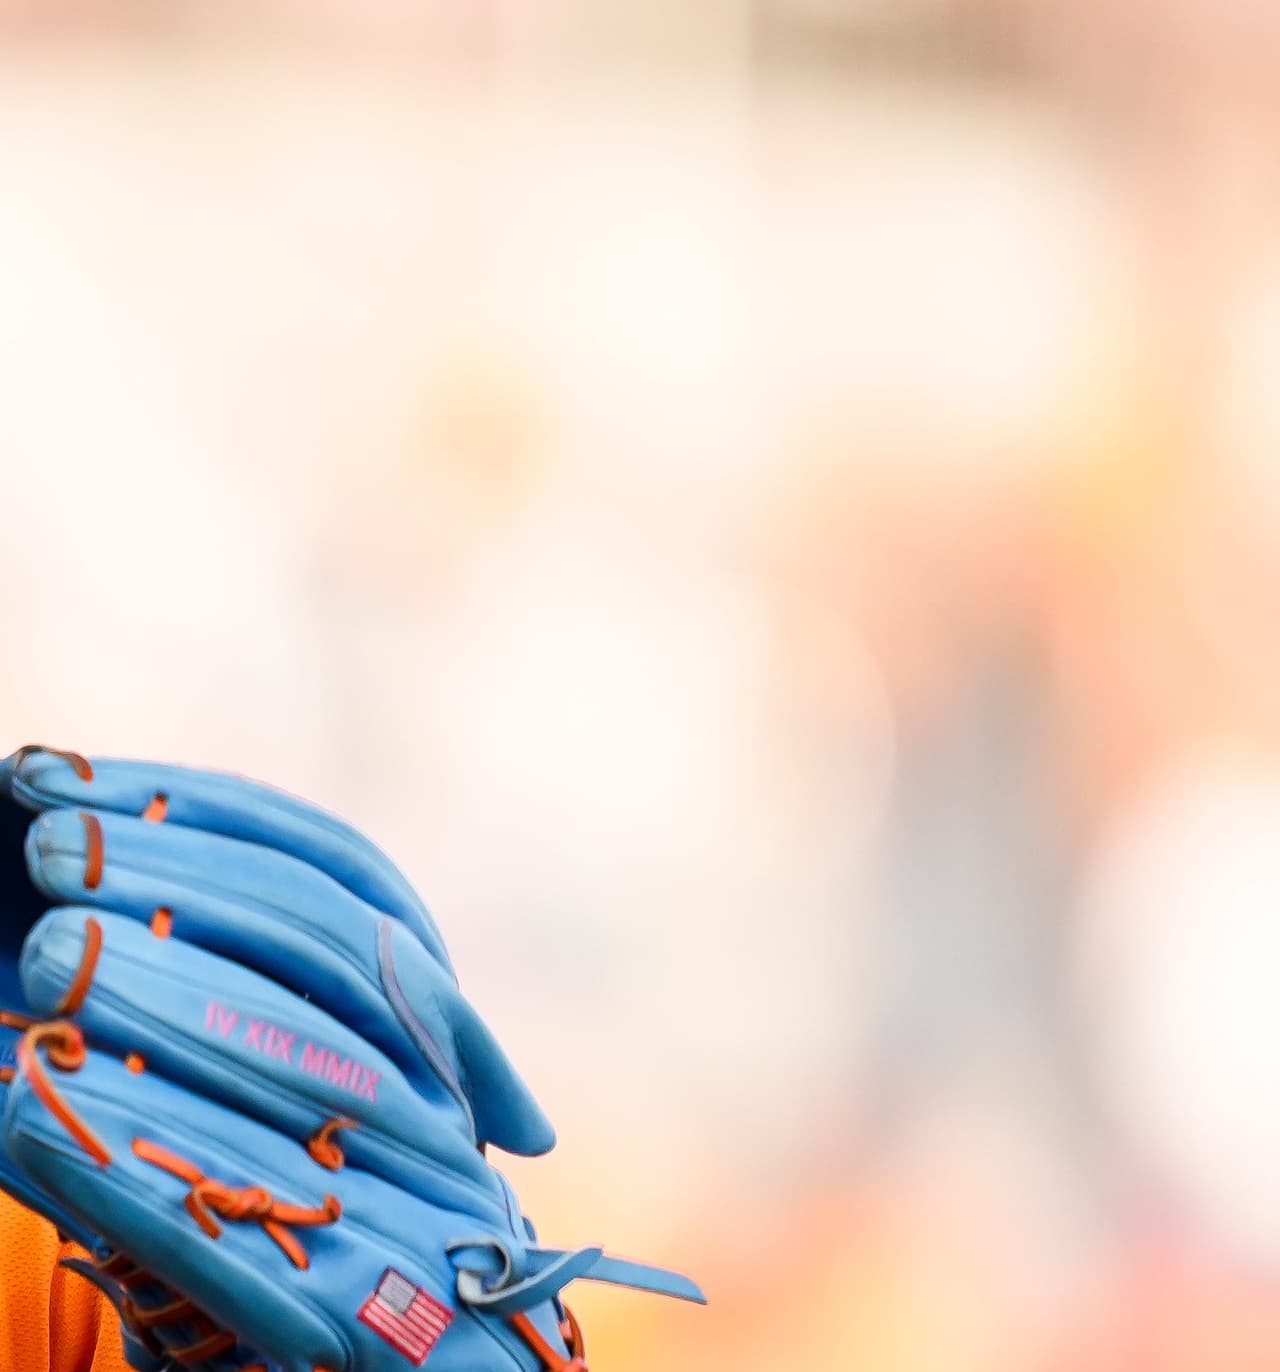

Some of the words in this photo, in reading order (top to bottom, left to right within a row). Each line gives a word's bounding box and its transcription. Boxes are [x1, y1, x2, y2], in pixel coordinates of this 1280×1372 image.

[204, 1000, 241, 1039] IV
[243, 1017, 299, 1066] XIX
[300, 1040, 383, 1103] MMIX
